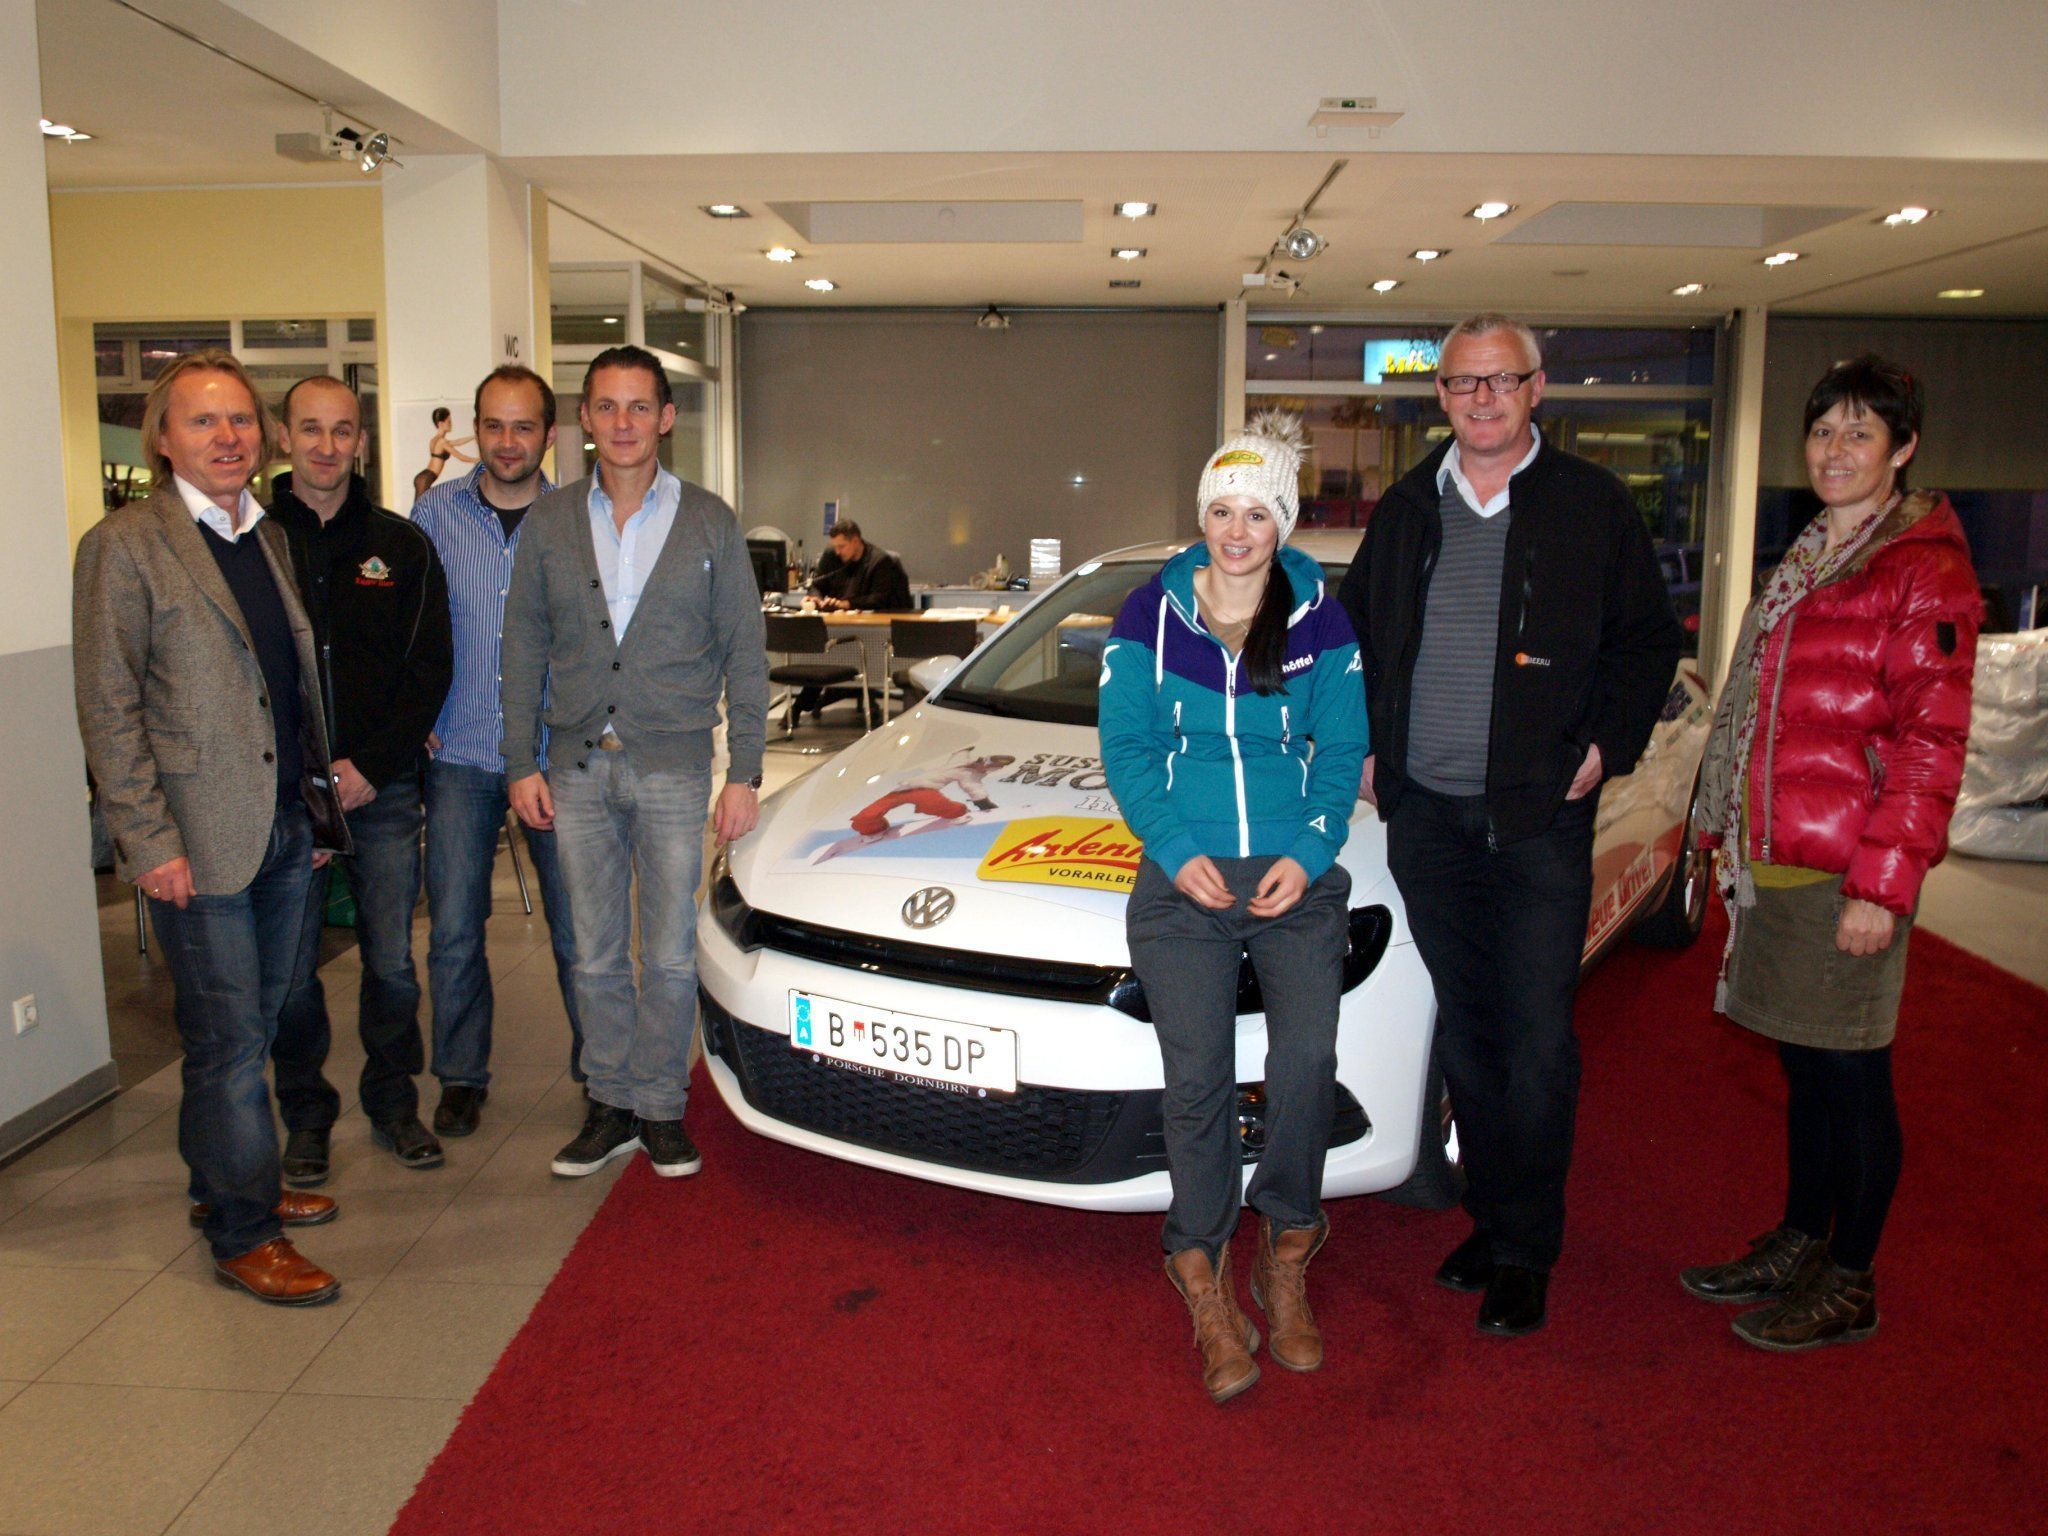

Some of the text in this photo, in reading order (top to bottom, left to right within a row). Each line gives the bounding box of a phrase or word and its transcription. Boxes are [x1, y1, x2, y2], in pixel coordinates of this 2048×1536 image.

[504, 333, 519, 358] WC
[1048, 867, 1137, 885] VORARLBE
[828, 1011, 986, 1075] B 535 DP
[826, 1057, 971, 1096] PORSCHE DORNBIRN
